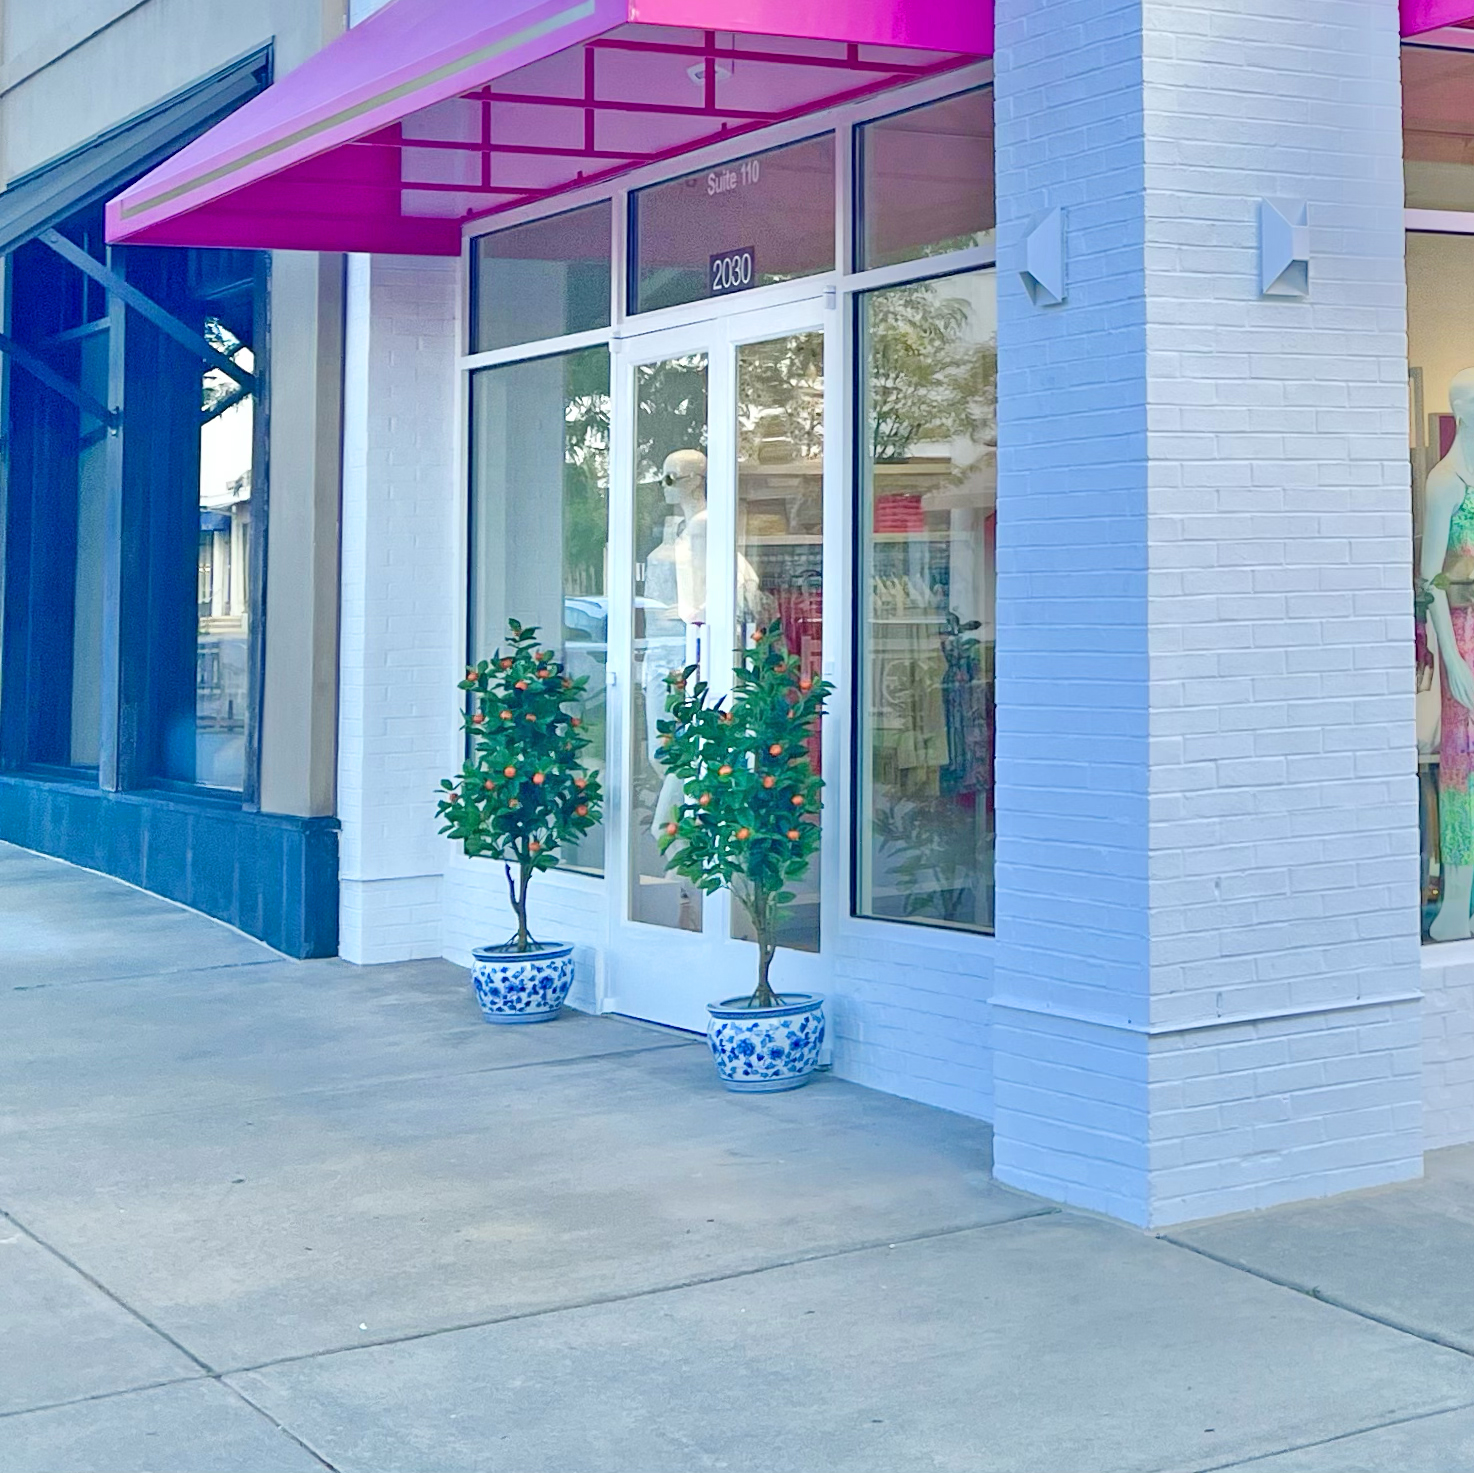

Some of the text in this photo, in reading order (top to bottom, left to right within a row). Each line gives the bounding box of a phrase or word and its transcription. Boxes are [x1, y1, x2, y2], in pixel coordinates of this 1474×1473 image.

[707, 160, 760, 196] Suite 110
[712, 253, 752, 290] 2030
